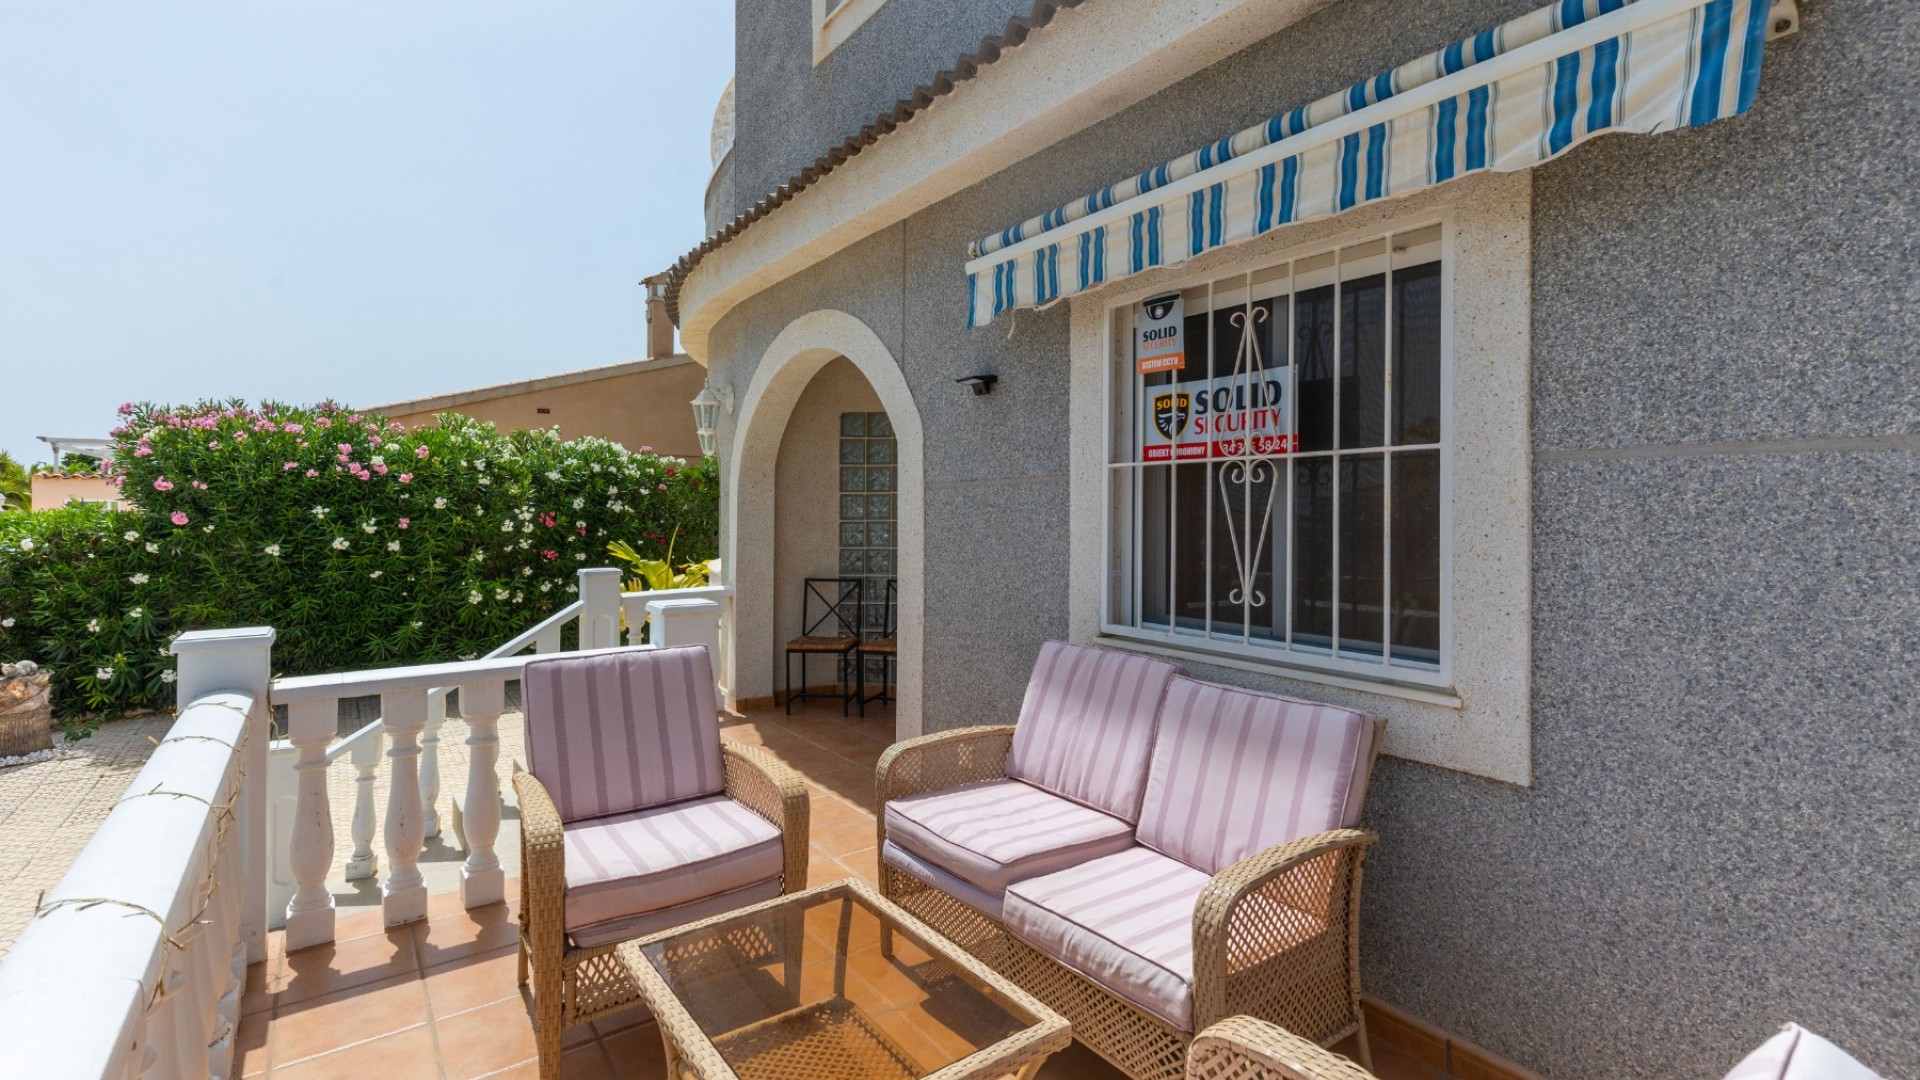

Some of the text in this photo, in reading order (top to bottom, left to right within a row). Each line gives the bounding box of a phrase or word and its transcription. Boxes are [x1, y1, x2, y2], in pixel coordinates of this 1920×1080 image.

[1143, 325, 1177, 343] SOLID
[1143, 337, 1178, 352] SECURITY
[1156, 398, 1187, 410] SOID
[1195, 380, 1282, 415] SOLID
